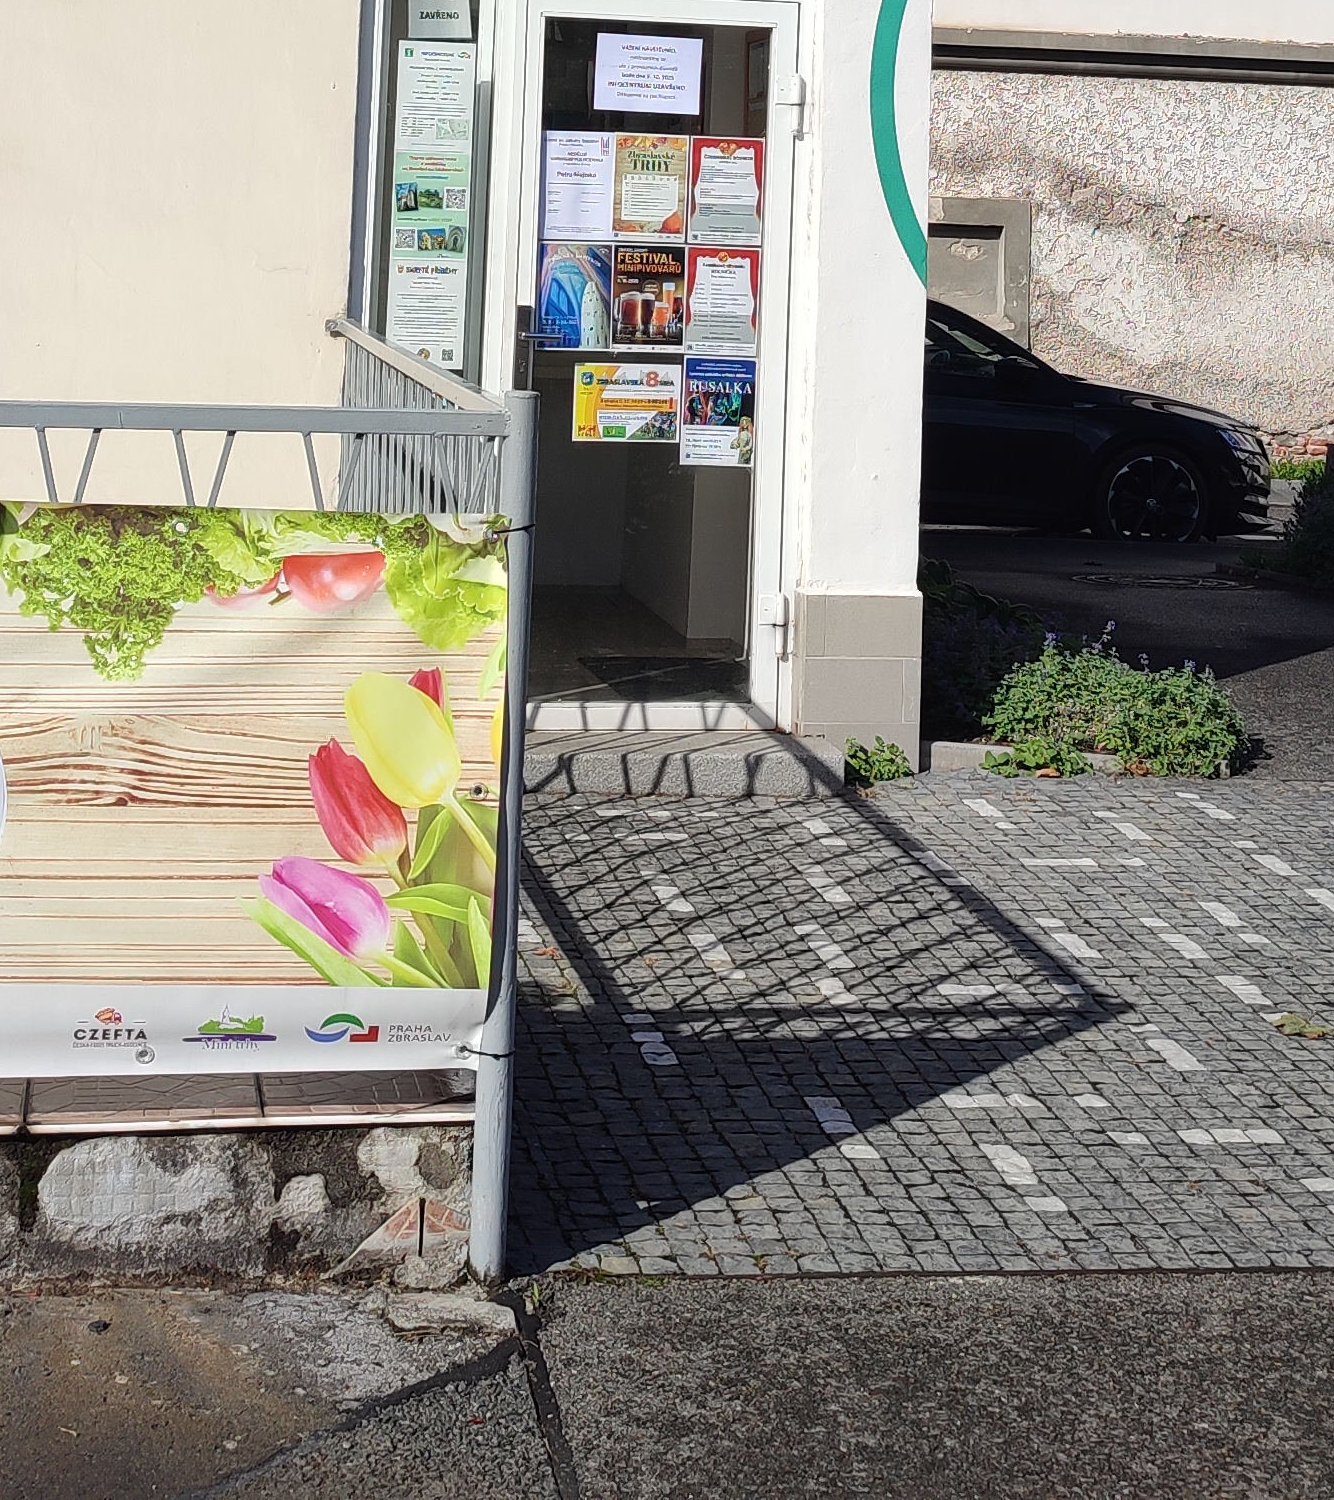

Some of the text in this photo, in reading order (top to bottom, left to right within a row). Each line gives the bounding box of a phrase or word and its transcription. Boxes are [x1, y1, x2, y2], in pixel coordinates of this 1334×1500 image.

[630, 159, 672, 173] TRHY
[617, 252, 676, 265] FESTIVAL
[617, 263, 682, 274] MINIPIVOVARŮ
[689, 379, 752, 395] RUSALKA
[388, 1025, 433, 1034] PRAHA
[202, 1038, 233, 1050] Mini
[387, 1033, 452, 1043] ZBRASLAV
